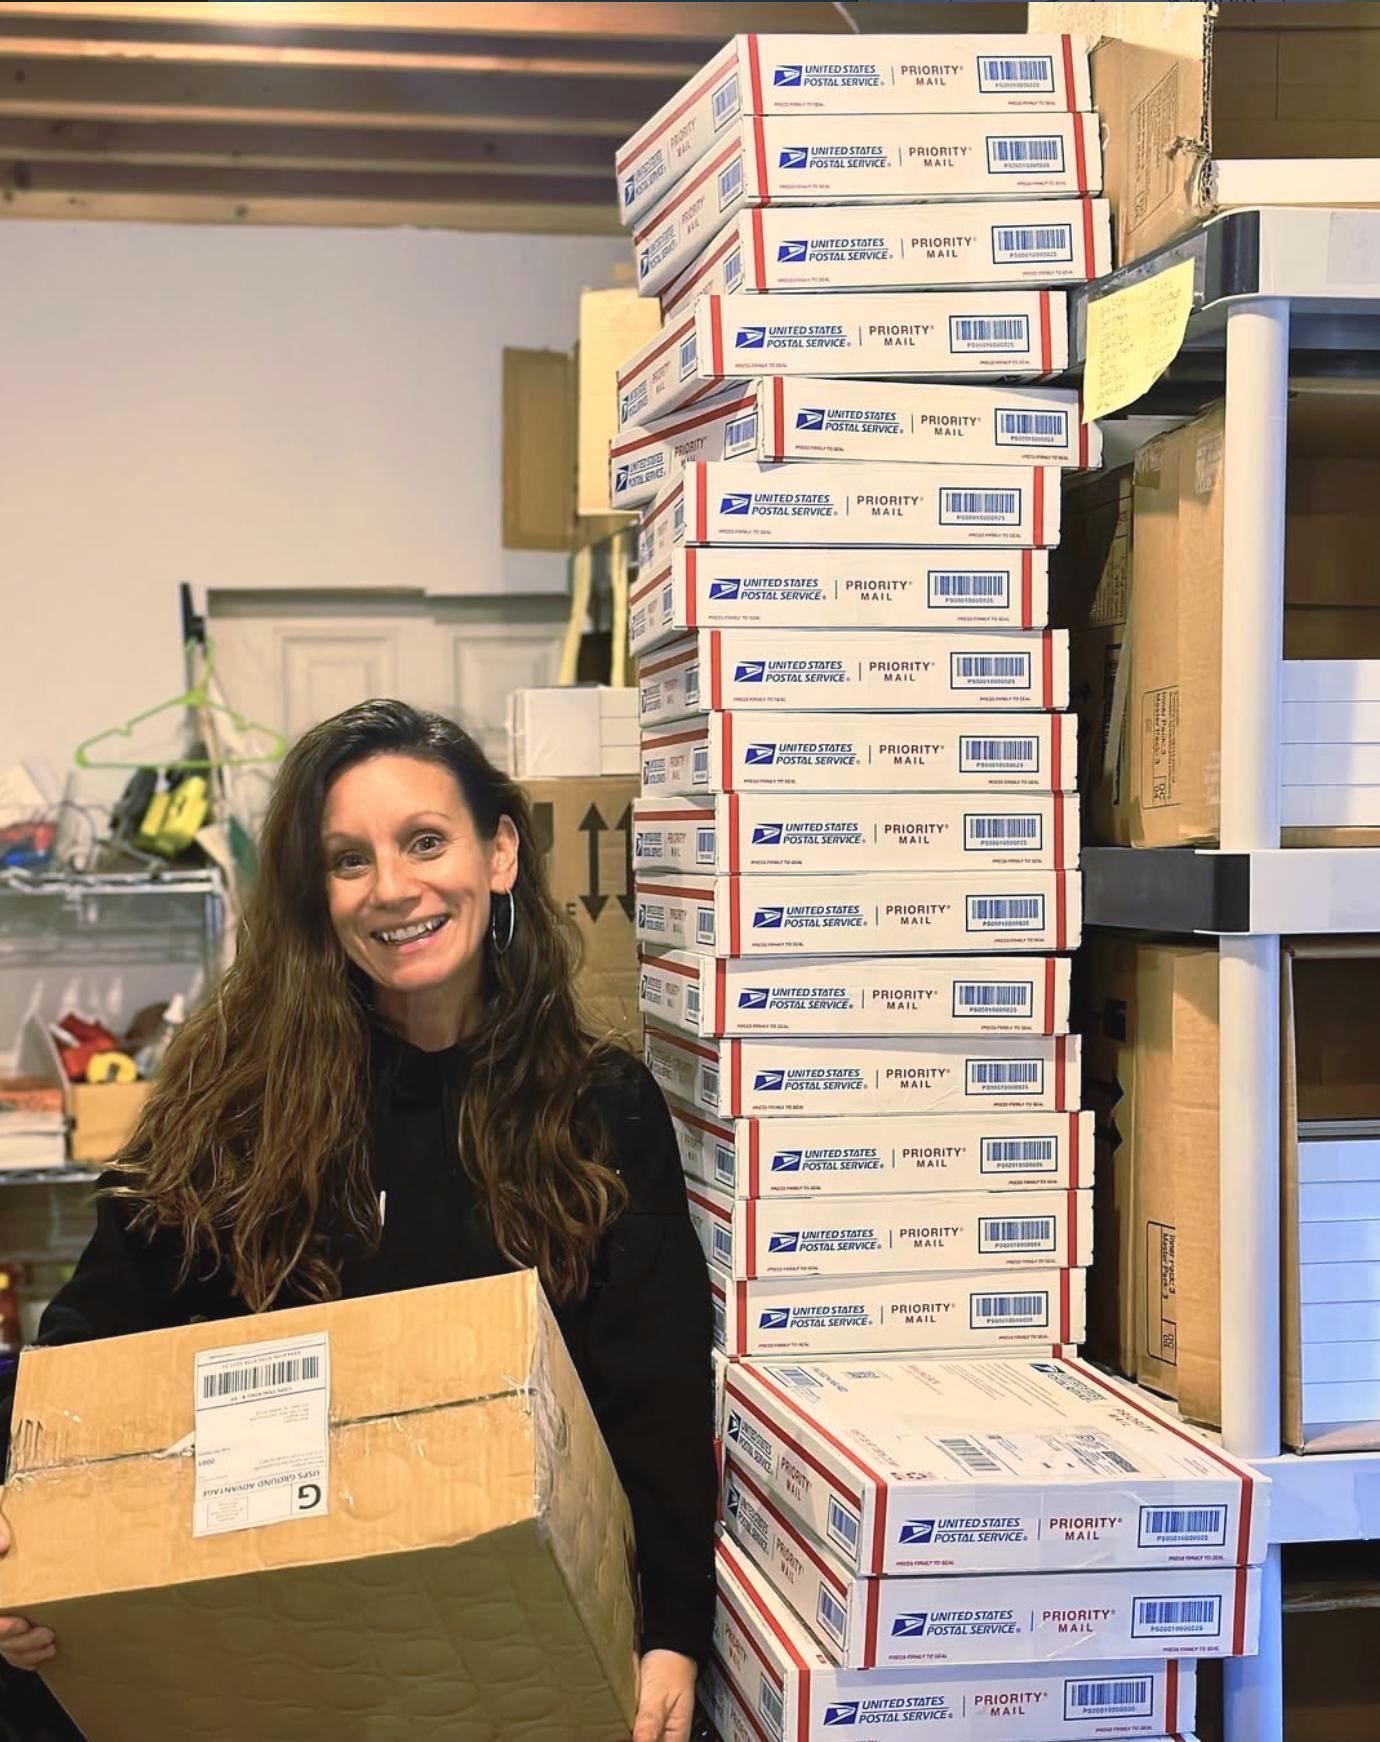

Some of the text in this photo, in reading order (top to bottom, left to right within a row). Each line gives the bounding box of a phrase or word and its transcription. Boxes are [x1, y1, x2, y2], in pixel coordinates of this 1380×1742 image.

[805, 65, 876, 74] UNITED STATES
[901, 65, 960, 76] PRIORITY
[804, 77, 879, 87] POSTAL SERVICE
[916, 77, 947, 86] MAIL
[811, 146, 883, 155] UNITED STATES
[908, 145, 968, 157] PRIORITY
[809, 158, 886, 169] POSTAL SERVICE
[923, 158, 955, 167] MAIL
[811, 238, 884, 248] UNITED STATES
[911, 236, 972, 248] PRIORITY
[809, 250, 888, 261] POSTAL SERVICE
[926, 248, 958, 258] MAIL
[769, 325, 842, 335] UNITED STATES
[869, 325, 930, 336] PRIORITY
[767, 338, 846, 348] POSTAL SERVICE
[884, 337, 916, 346] MAIL
[827, 410, 896, 421] UNITED STATES
[921, 414, 977, 427] PRIORITY
[825, 422, 899, 434] POSTAL SERVICE
[934, 427, 964, 436] MAIL
[754, 493, 830, 503] UNITED STATES
[857, 495, 919, 507] PRIORITY
[751, 506, 832, 516] POSTAL SERVICE
[871, 508, 904, 517] MAIL
[743, 578, 819, 587] UNITED STATES
[845, 579, 908, 590] PRIORITY
[740, 591, 821, 600] POSTAL SERVICE
[860, 592, 893, 601] MAIL
[768, 660, 843, 670] UNITED STATES
[869, 661, 930, 672] PRIORITY
[765, 673, 845, 683] POSTAL SERVICE
[884, 673, 916, 682] MAIL
[778, 743, 853, 752] UNITED STATES
[879, 744, 940, 755] PRIORITY
[776, 756, 855, 765] POSTAL SERVICE
[894, 756, 925, 765] MAIL
[785, 823, 859, 832] UNITED STATES
[884, 823, 944, 834] PRIORITY
[782, 835, 861, 845] POSTAL SERVICE
[899, 835, 930, 844] MAIL
[786, 905, 860, 915] UNITED STATES
[886, 904, 946, 916] PRIORITY
[784, 917, 862, 928] POSTAL SERVICE
[900, 916, 932, 926] MAIL
[772, 988, 846, 997] UNITED STATES
[872, 989, 933, 1000] PRIORITY
[768, 1000, 848, 1009] POSTAL SERVICE
[886, 1001, 918, 1010] MAIL
[787, 1069, 860, 1078] UNITED STATES
[886, 1068, 946, 1079] PRIORITY
[784, 1081, 863, 1090] POSTAL SERVICE
[900, 1080, 932, 1089] MAIL
[804, 1148, 876, 1159] UNITED STATES
[902, 1147, 961, 1158] PRIORITY
[802, 1160, 879, 1171] POSTAL SERVICE
[916, 1159, 947, 1168] MAIL
[801, 1229, 874, 1240] UNITED STATES
[899, 1227, 959, 1239] PRIORITY
[799, 1241, 877, 1252] POSTAL SERVICE
[914, 1239, 945, 1248] MAIL
[792, 1305, 865, 1316] UNITED STATES
[891, 1303, 951, 1315] PRIORITY
[790, 1317, 868, 1328] POSTAL SERVICE
[905, 1315, 937, 1324] MAIL
[203, 1470, 320, 1497] USPS GROUND ADVANTAGE
[298, 1484, 321, 1510] G
[937, 1518, 1021, 1529] UNITED STATES
[1049, 1516, 1117, 1530] PRIORITY
[933, 1532, 1023, 1544] POSTAL SERVICE
[1065, 1530, 1101, 1541] MAIL
[930, 1610, 1014, 1622] UNITED STATES
[1042, 1608, 1111, 1622] PRIORITY
[925, 1624, 1016, 1637] POSTAL SERVICE
[1058, 1622, 1094, 1633] MAIL
[862, 1696, 945, 1710] UNITED STATES
[974, 1691, 1042, 1707] PRIORITY
[990, 1705, 1026, 1717] MAIL
[858, 1710, 947, 1724] POSTAL SERVICE
